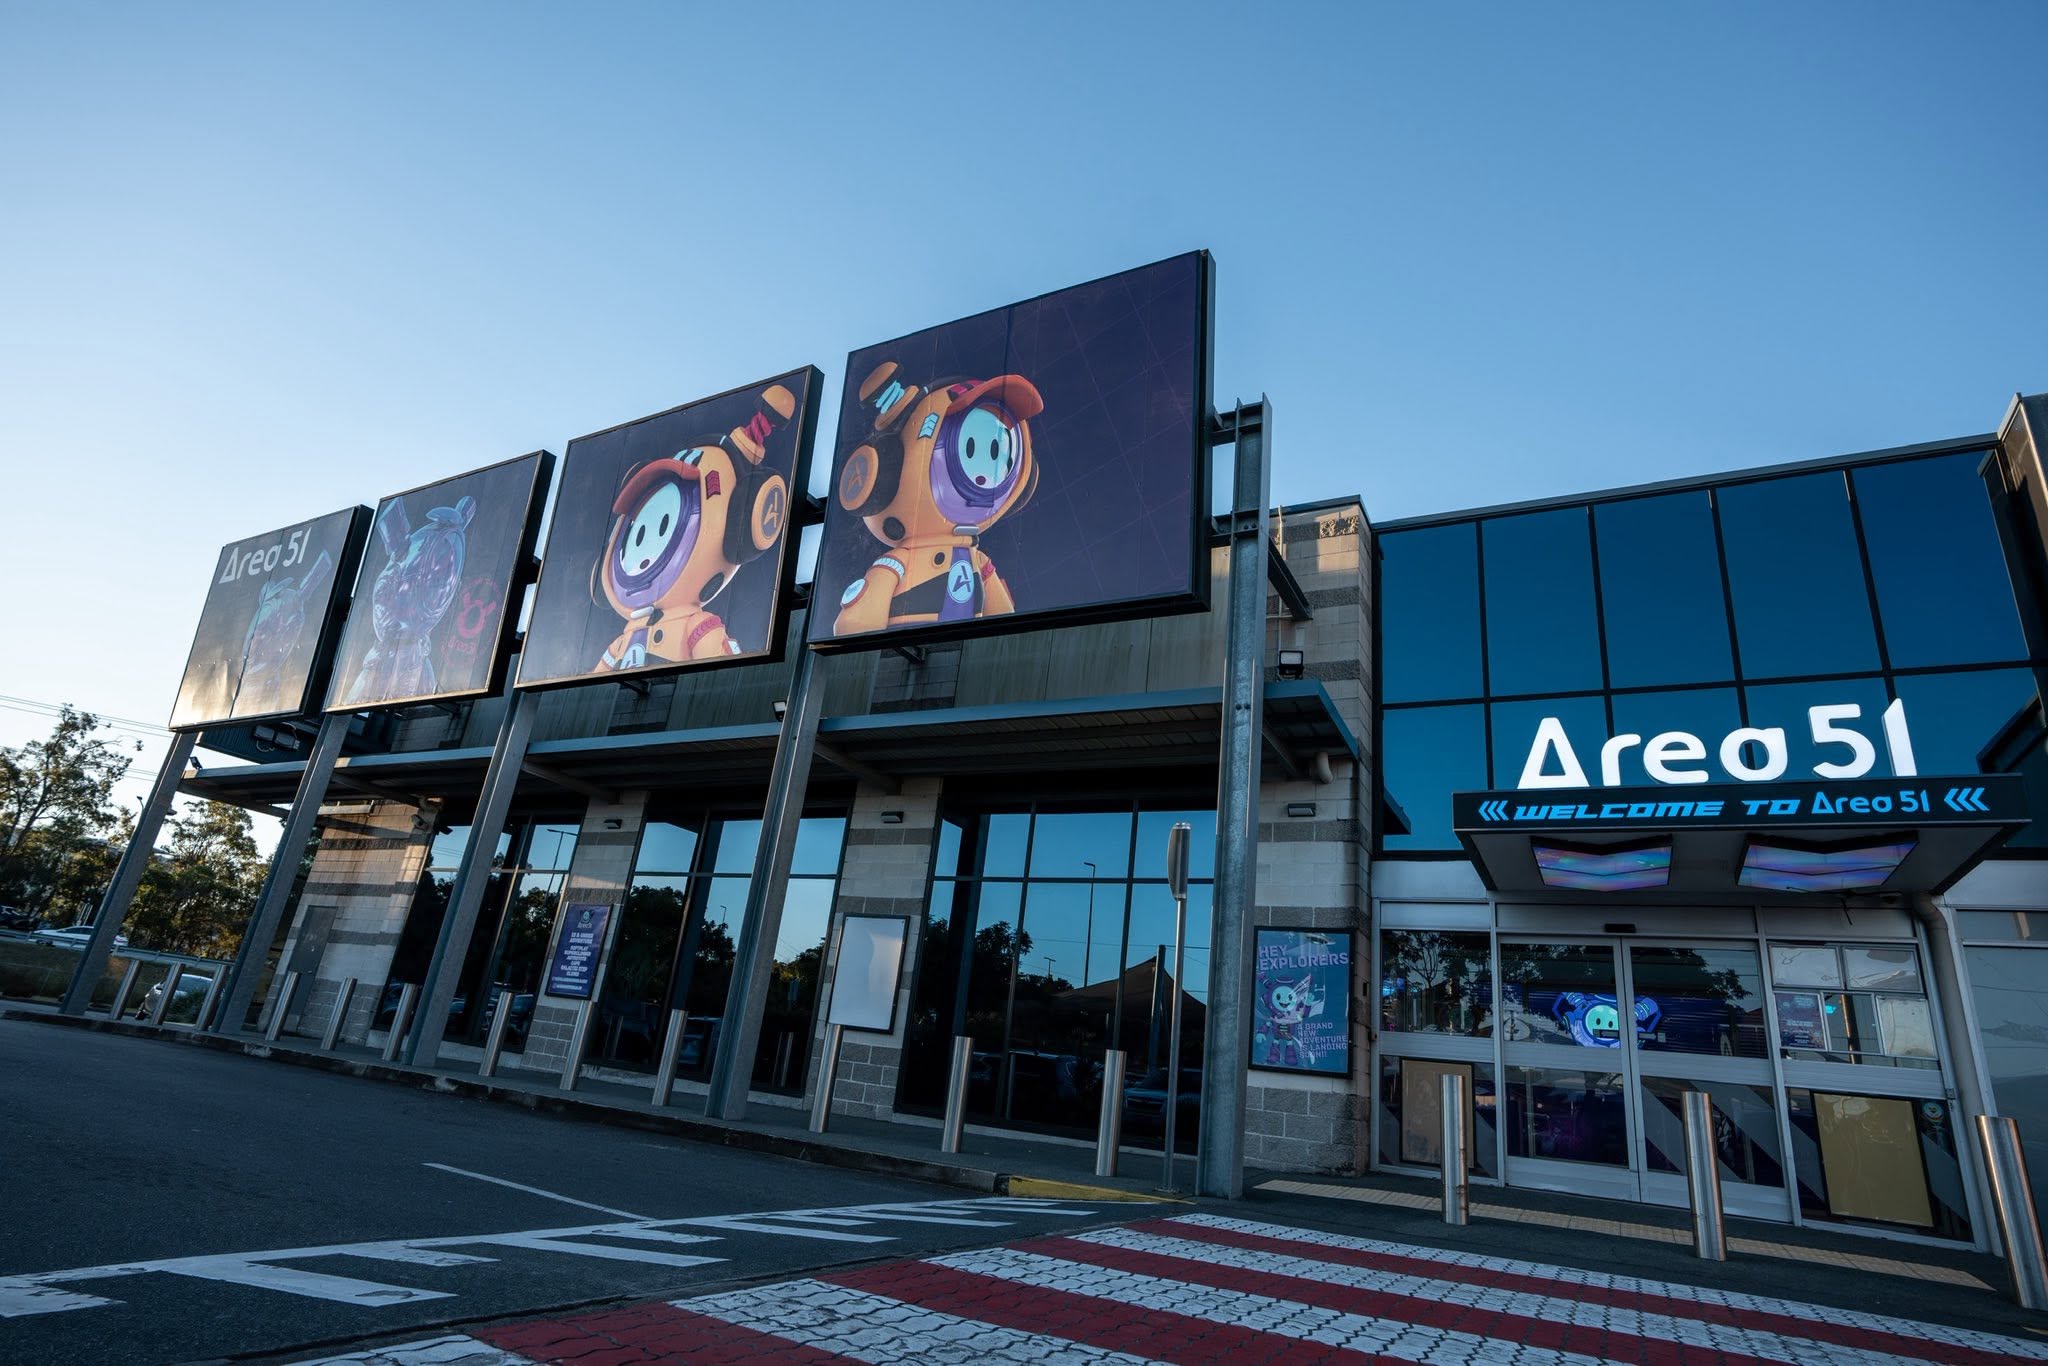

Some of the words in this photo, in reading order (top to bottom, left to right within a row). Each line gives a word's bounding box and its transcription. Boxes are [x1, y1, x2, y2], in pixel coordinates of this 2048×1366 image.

[218, 543, 284, 584] Area
[281, 526, 311, 568] 51
[1517, 716, 1789, 791] Area
[1808, 697, 1918, 779] 51
[1513, 800, 1726, 821] WELCOME
[1742, 799, 1802, 818] TO
[1811, 790, 1893, 815] Area
[1899, 790, 1931, 813] 51
[1259, 945, 1288, 958] HEY
[1259, 953, 1349, 971] EXPLORERS
[1305, 1022, 1334, 1030] BRAND
[1299, 1035, 1348, 1044] ADVENTURE
[1310, 1043, 1347, 1051] LANDING
